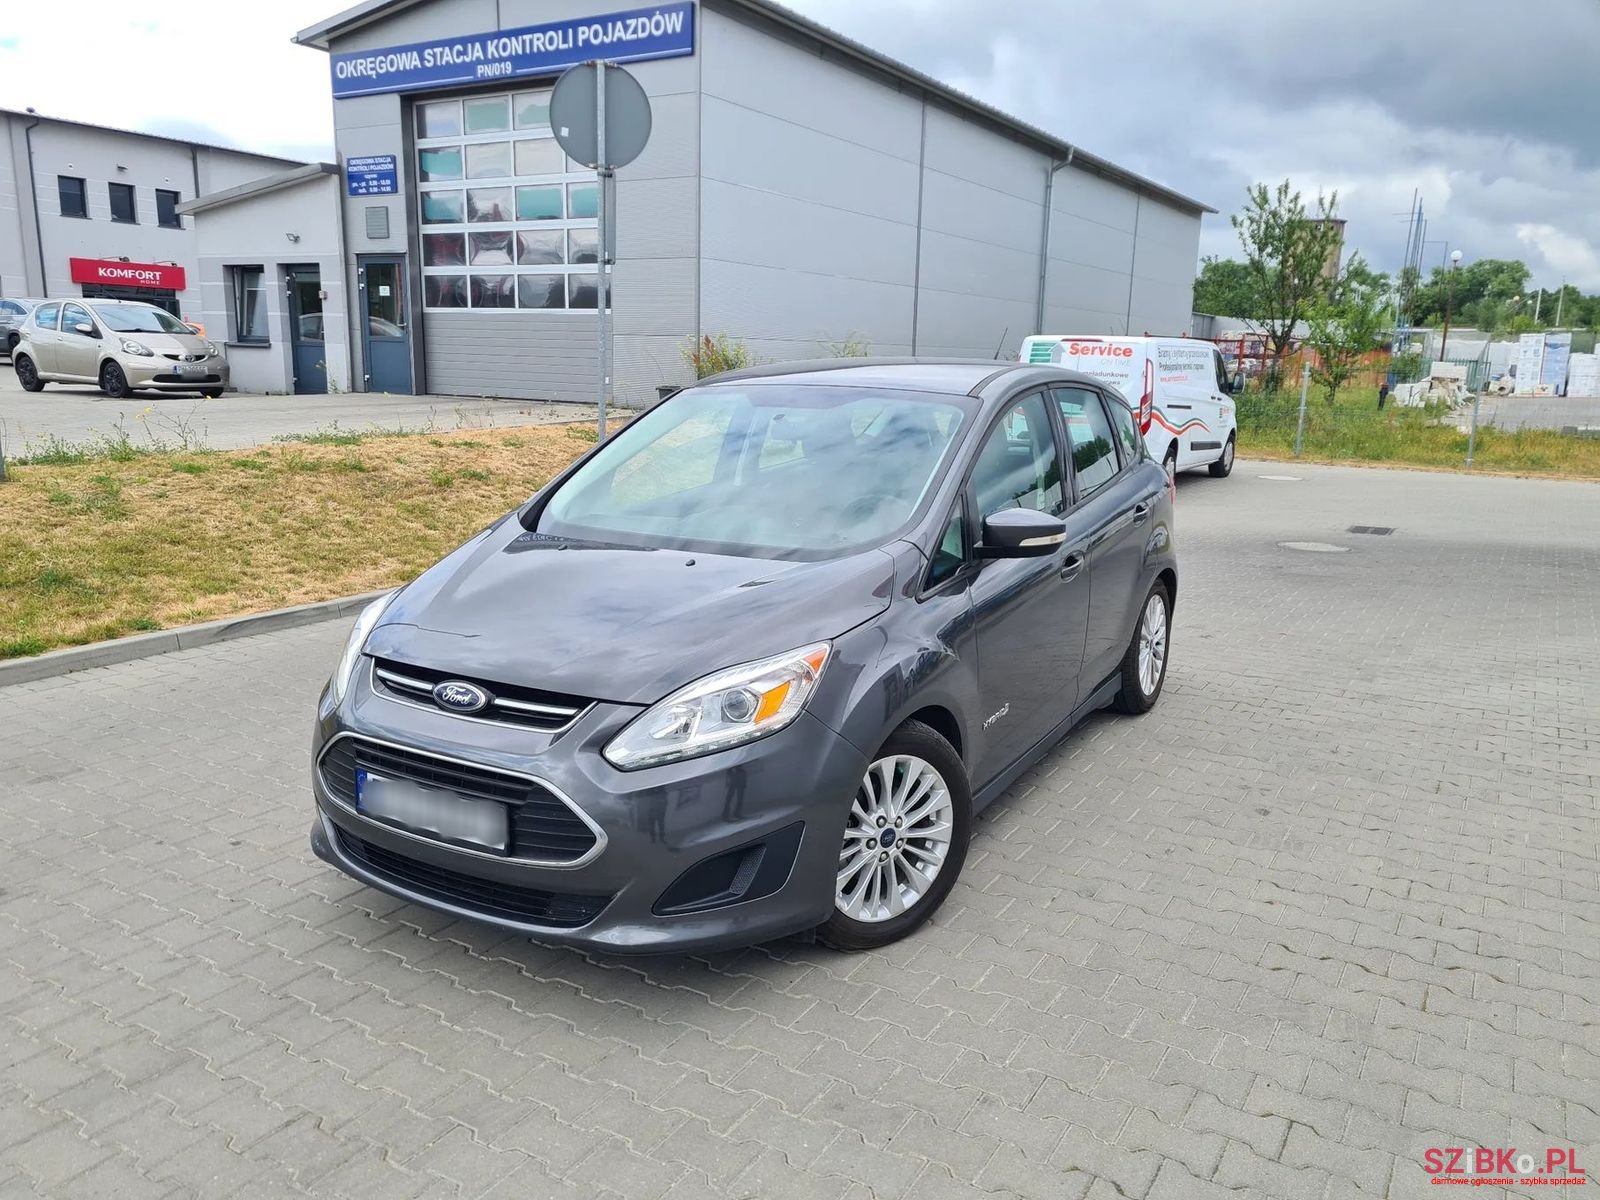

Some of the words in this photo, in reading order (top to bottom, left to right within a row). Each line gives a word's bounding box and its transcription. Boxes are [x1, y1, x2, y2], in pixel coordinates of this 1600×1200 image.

[336, 52, 421, 79] OKRĘGOWA
[424, 42, 484, 67] STACJA
[487, 28, 573, 59] KONTROLI
[578, 11, 684, 47] POJAZDÓW
[477, 61, 512, 78] PN/019
[98, 267, 162, 281] KOMFORT
[1069, 342, 1133, 357] Service
[442, 685, 472, 705] Ford
